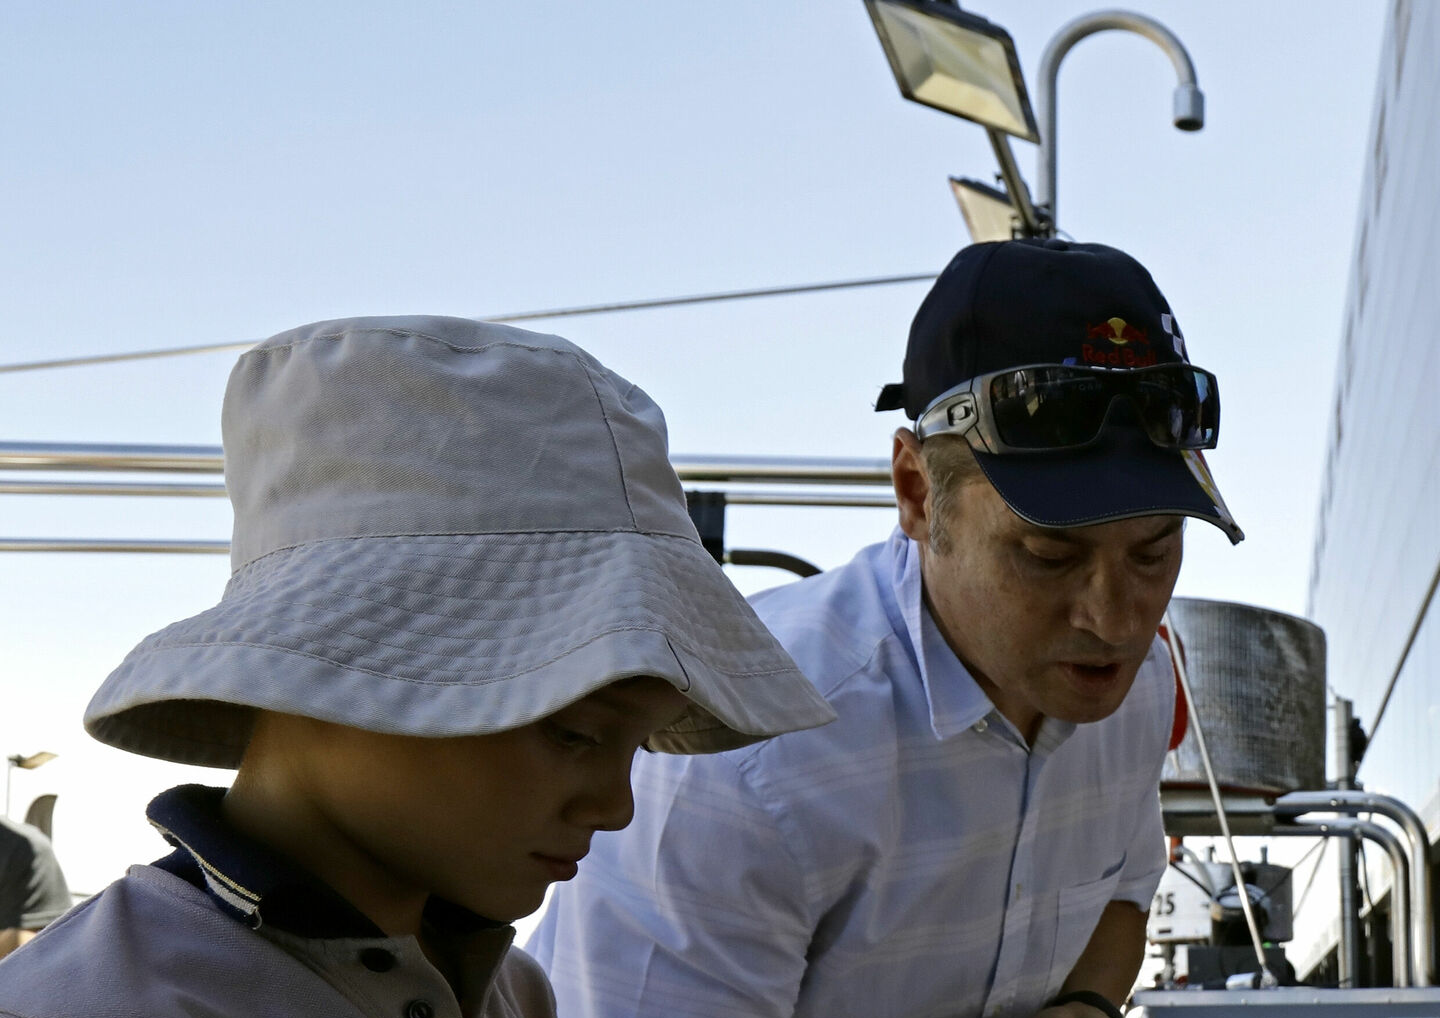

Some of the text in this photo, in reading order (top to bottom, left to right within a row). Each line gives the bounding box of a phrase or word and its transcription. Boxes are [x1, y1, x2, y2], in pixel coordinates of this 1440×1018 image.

[1082, 344, 1158, 367] Red Bull
[1155, 892, 1175, 915] 25
